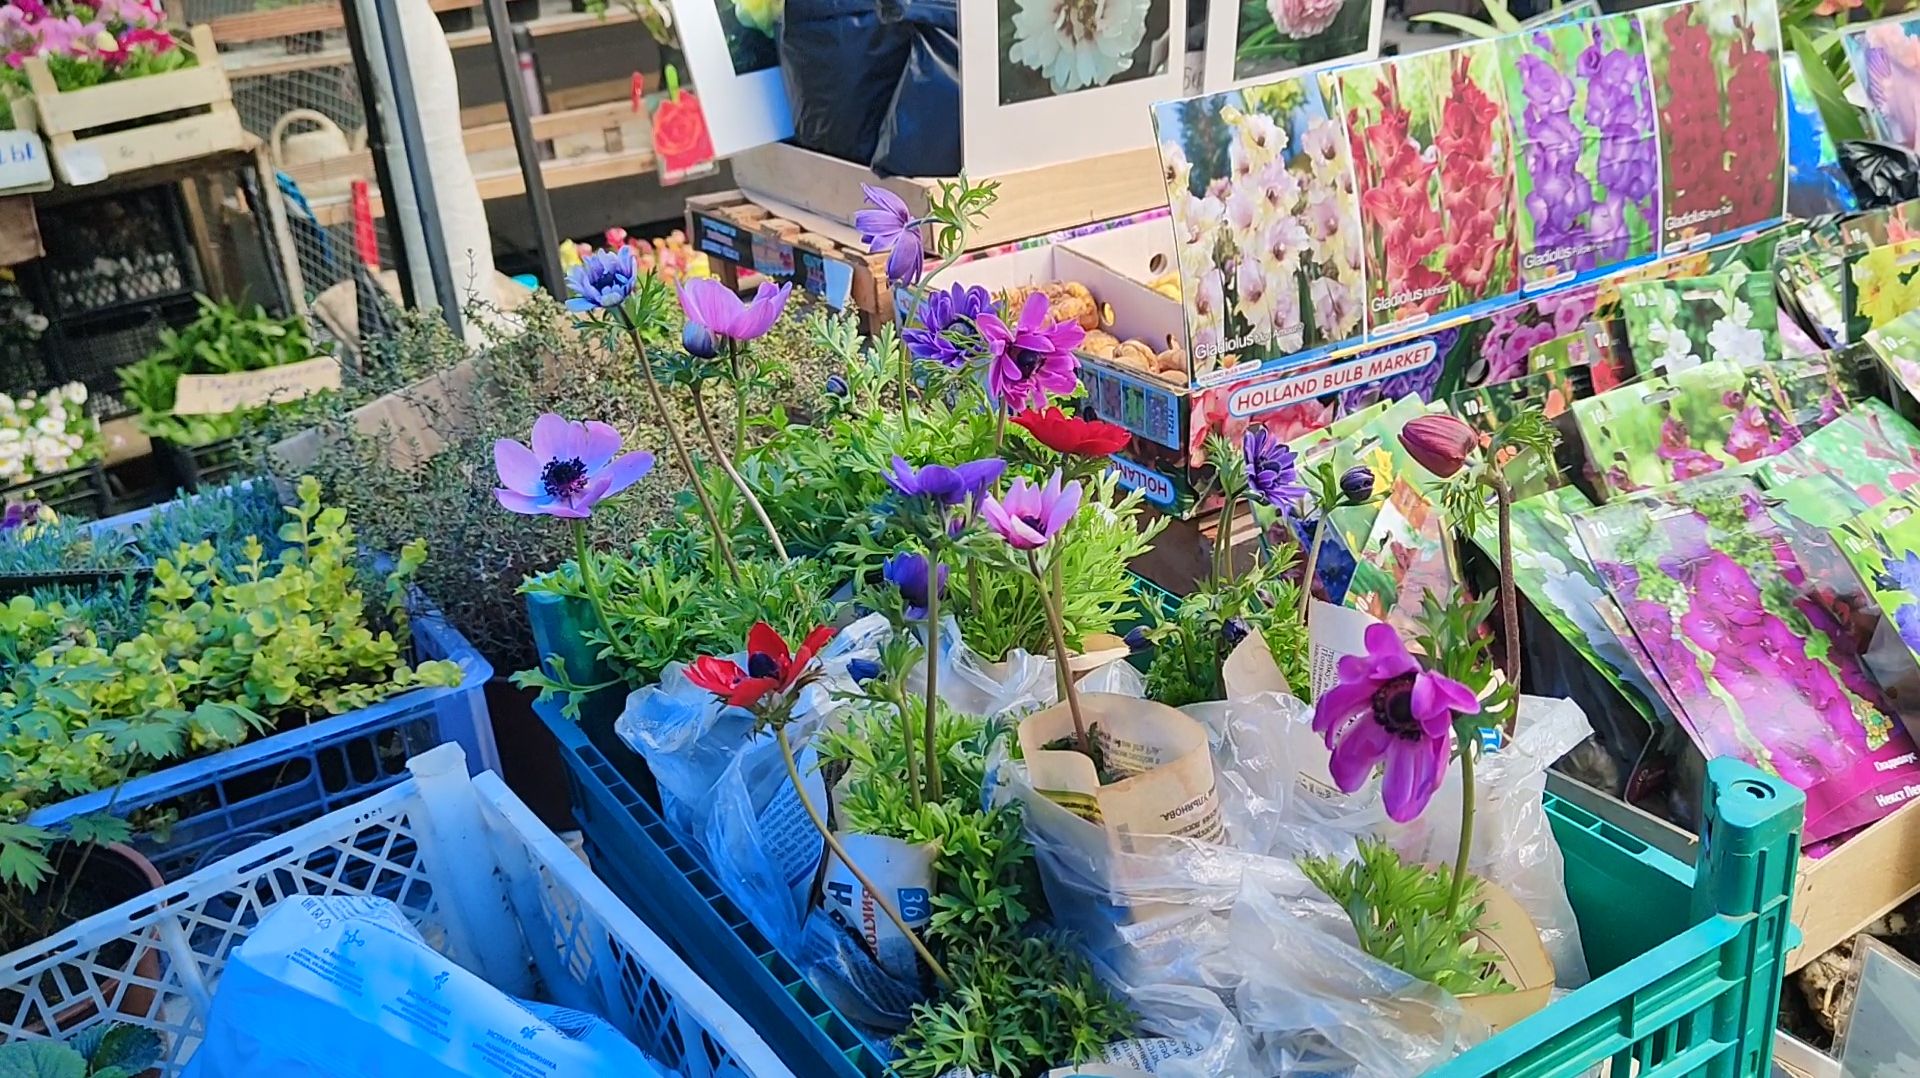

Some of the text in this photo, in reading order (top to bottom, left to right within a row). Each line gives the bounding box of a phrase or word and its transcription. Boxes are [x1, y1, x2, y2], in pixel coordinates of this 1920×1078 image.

[1523, 244, 1572, 270] Gladiolus
[1371, 288, 1423, 313] Gladiolus
[1632, 292, 1647, 307] 10
[1194, 334, 1255, 360] Gladiolus
[1595, 332, 1609, 348] 10
[1881, 336, 1898, 351] 10
[1535, 354, 1547, 369] 10
[1237, 346, 1433, 412] HOLLAND BULB MARKET
[1463, 399, 1480, 416] 10
[1588, 408, 1605, 425] 10
[1589, 521, 1610, 540] 10
[1844, 537, 1863, 553] 10
[1160, 792, 1209, 822] УЛЬЯНОВА.
[901, 890, 926, 918] 36
